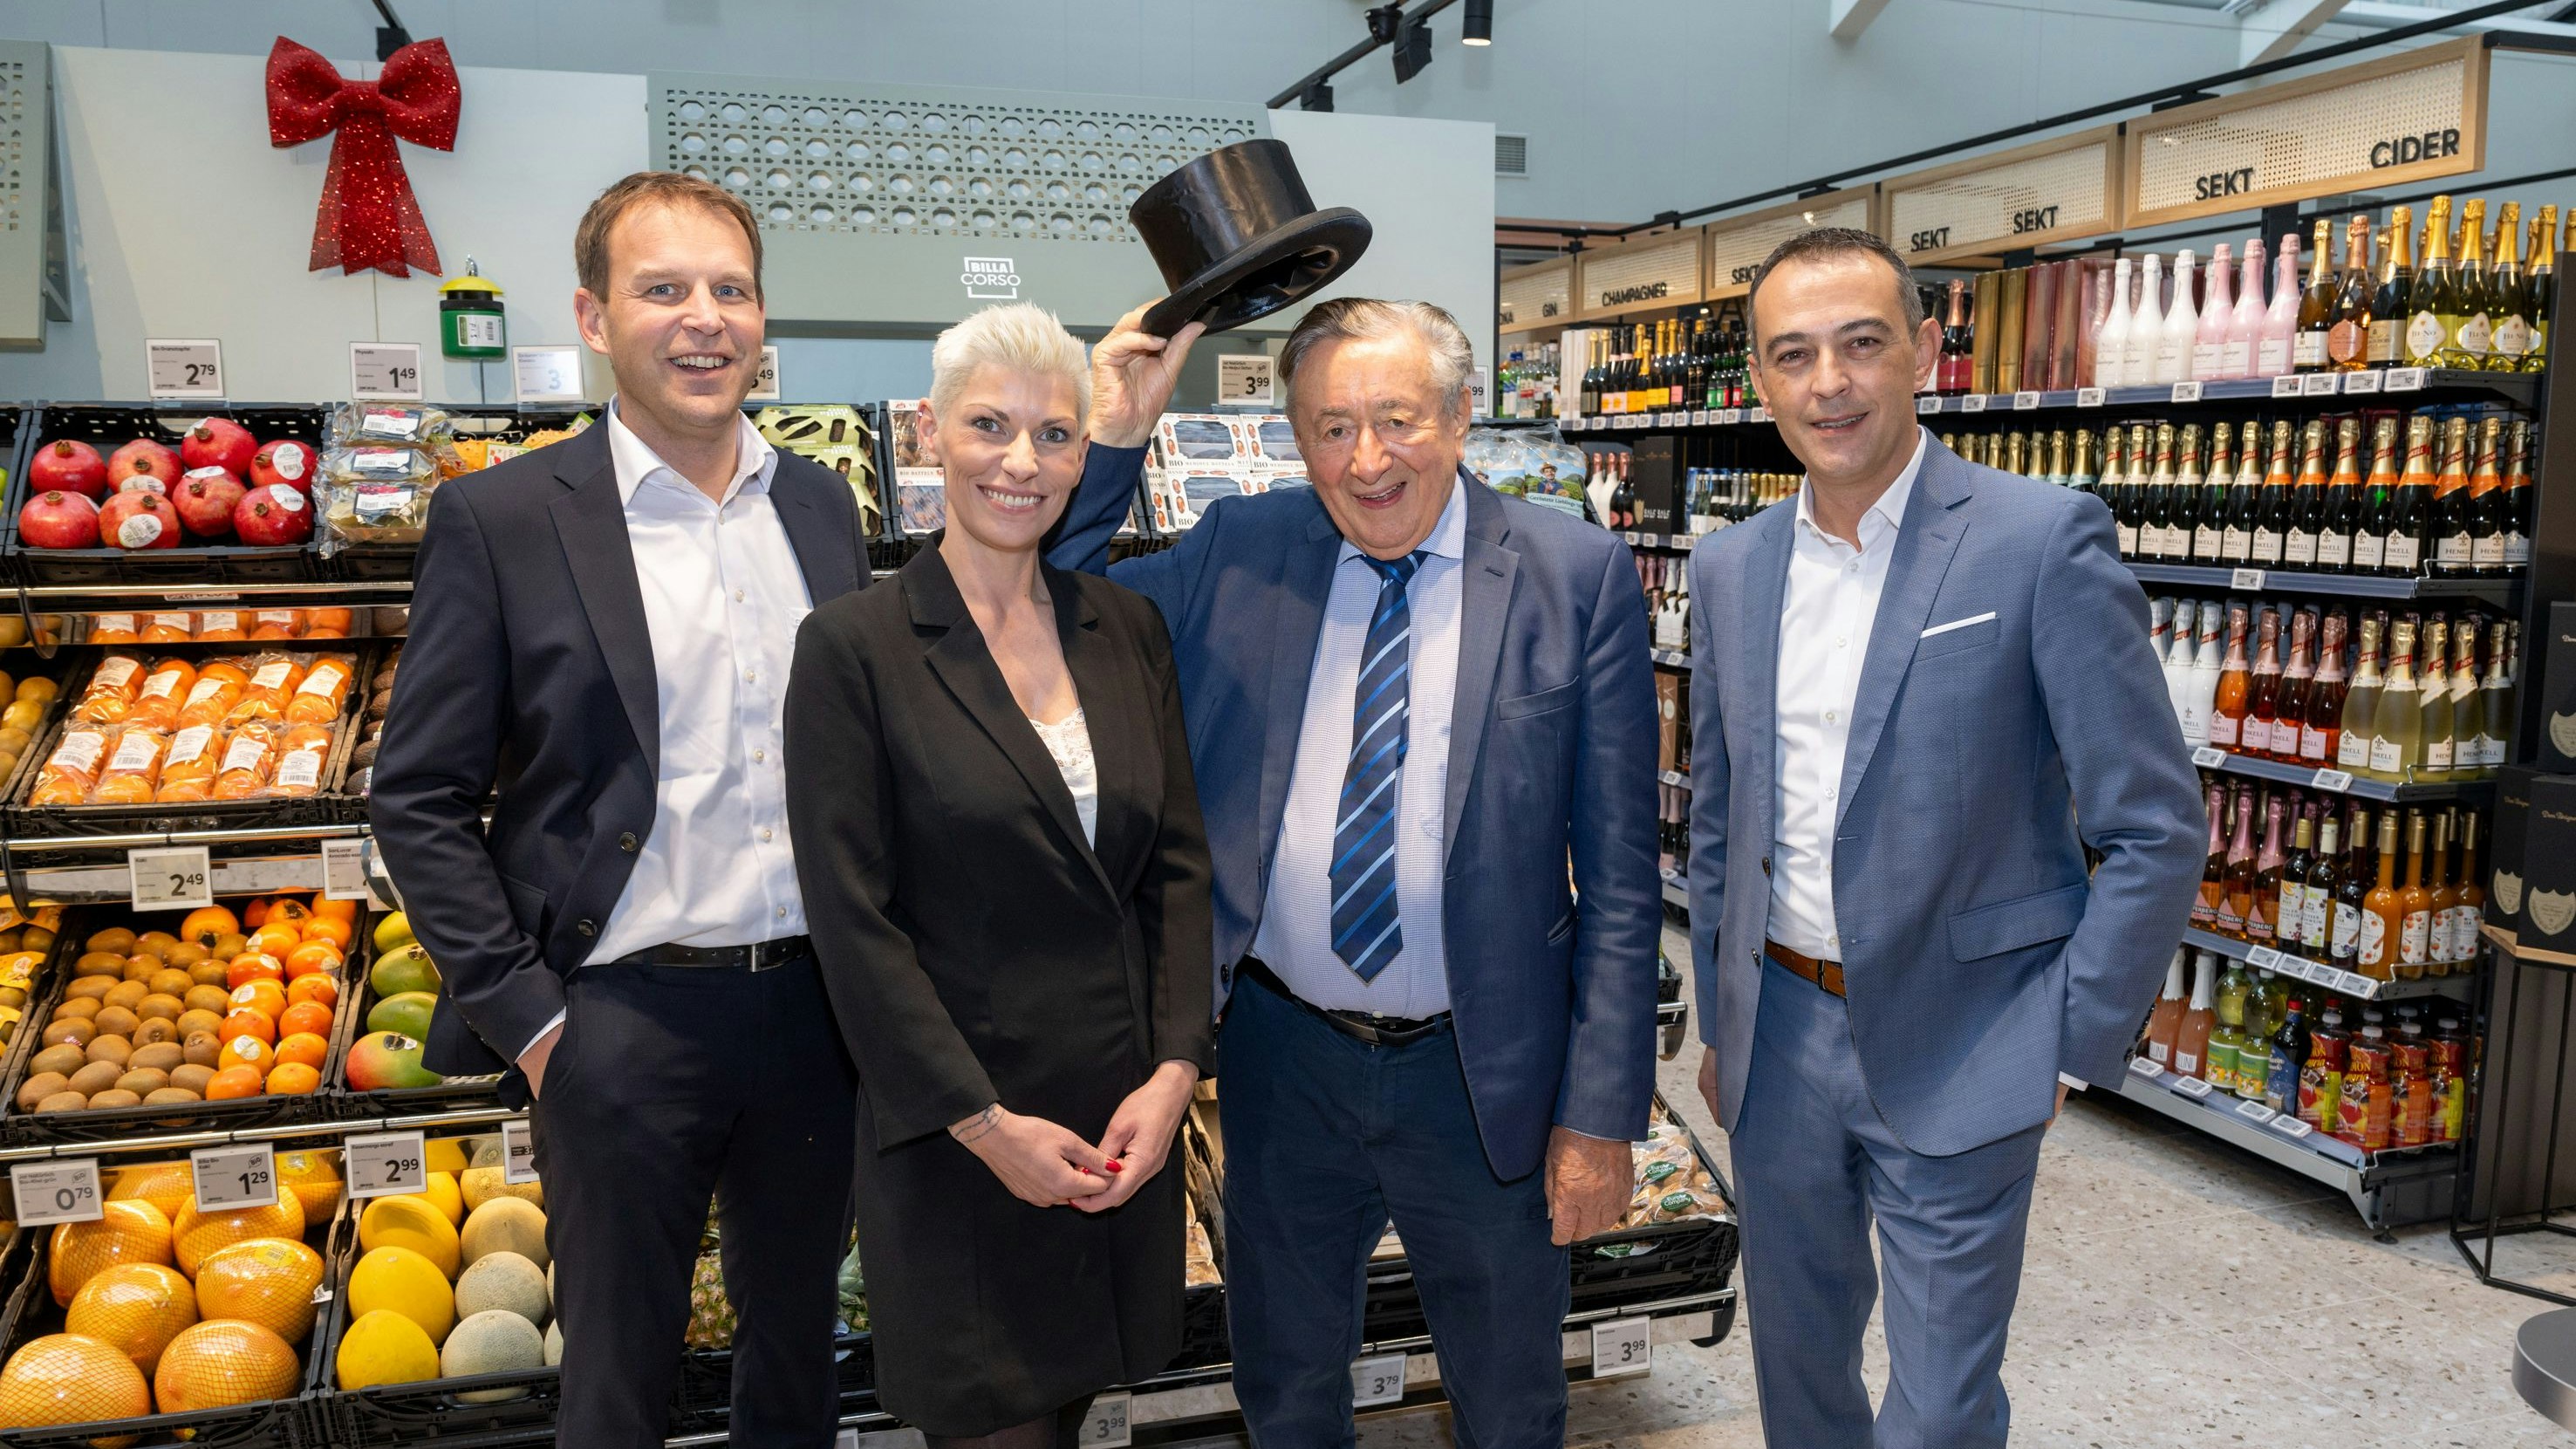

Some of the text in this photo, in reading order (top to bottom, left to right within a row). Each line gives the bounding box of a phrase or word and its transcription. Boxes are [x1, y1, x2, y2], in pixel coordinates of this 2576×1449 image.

[2371, 127, 2461, 169] CIDER
[2196, 167, 2255, 202] SEKT
[2014, 205, 2059, 234] SEKT
[1910, 226, 1950, 253] SEKT
[970, 262, 1008, 274] BILLA
[960, 273, 1022, 287] CORSO
[1602, 282, 1668, 307] CHAMPAGNER
[1542, 303, 1559, 318] GIN
[185, 364, 216, 385] 279
[389, 367, 416, 388] 149
[1246, 376, 1269, 395] 399
[169, 873, 204, 897] 249
[385, 1159, 419, 1182] 299
[1647, 1165, 1675, 1175] Company
[238, 1172, 269, 1195] 129
[55, 1186, 93, 1211] 079
[1664, 1195, 1691, 1206] Company
[1667, 1193, 1681, 1202] Euro
[1621, 1339, 1646, 1363] 399
[1372, 1375, 1399, 1395] 379
[1097, 1417, 1126, 1439] 399
